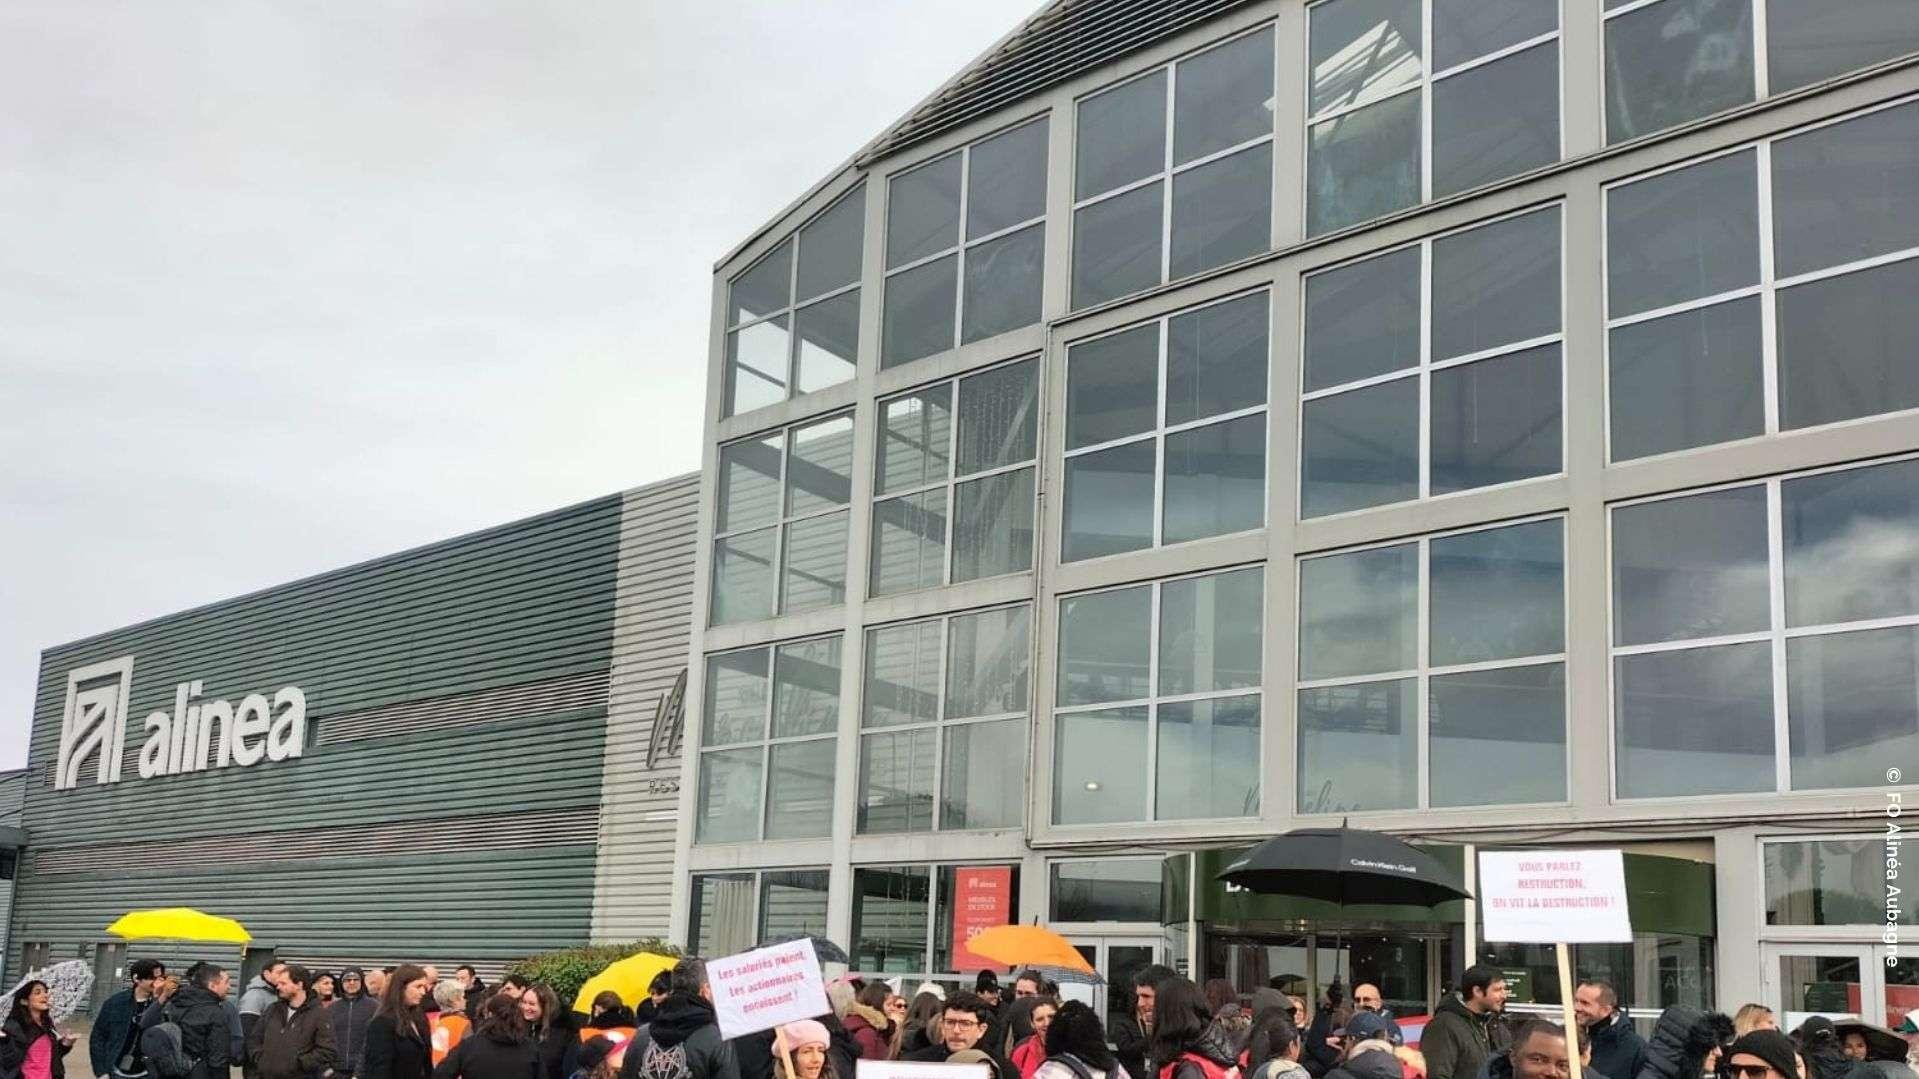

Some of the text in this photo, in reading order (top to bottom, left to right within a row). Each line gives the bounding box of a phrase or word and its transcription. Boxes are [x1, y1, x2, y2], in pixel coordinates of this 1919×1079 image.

[138, 680, 307, 779] alinea
[1518, 861, 1582, 873] VOUS PARLEZ
[1493, 898, 1507, 908] ON
[1510, 898, 1525, 908] VIT
[1528, 898, 1540, 908] LA
[1542, 897, 1608, 908] DESTRUCTION
[718, 968, 734, 980] Les
[736, 958, 773, 976] salariés
[729, 970, 804, 998] Les actionnaires
[742, 993, 793, 1013] encaissent
